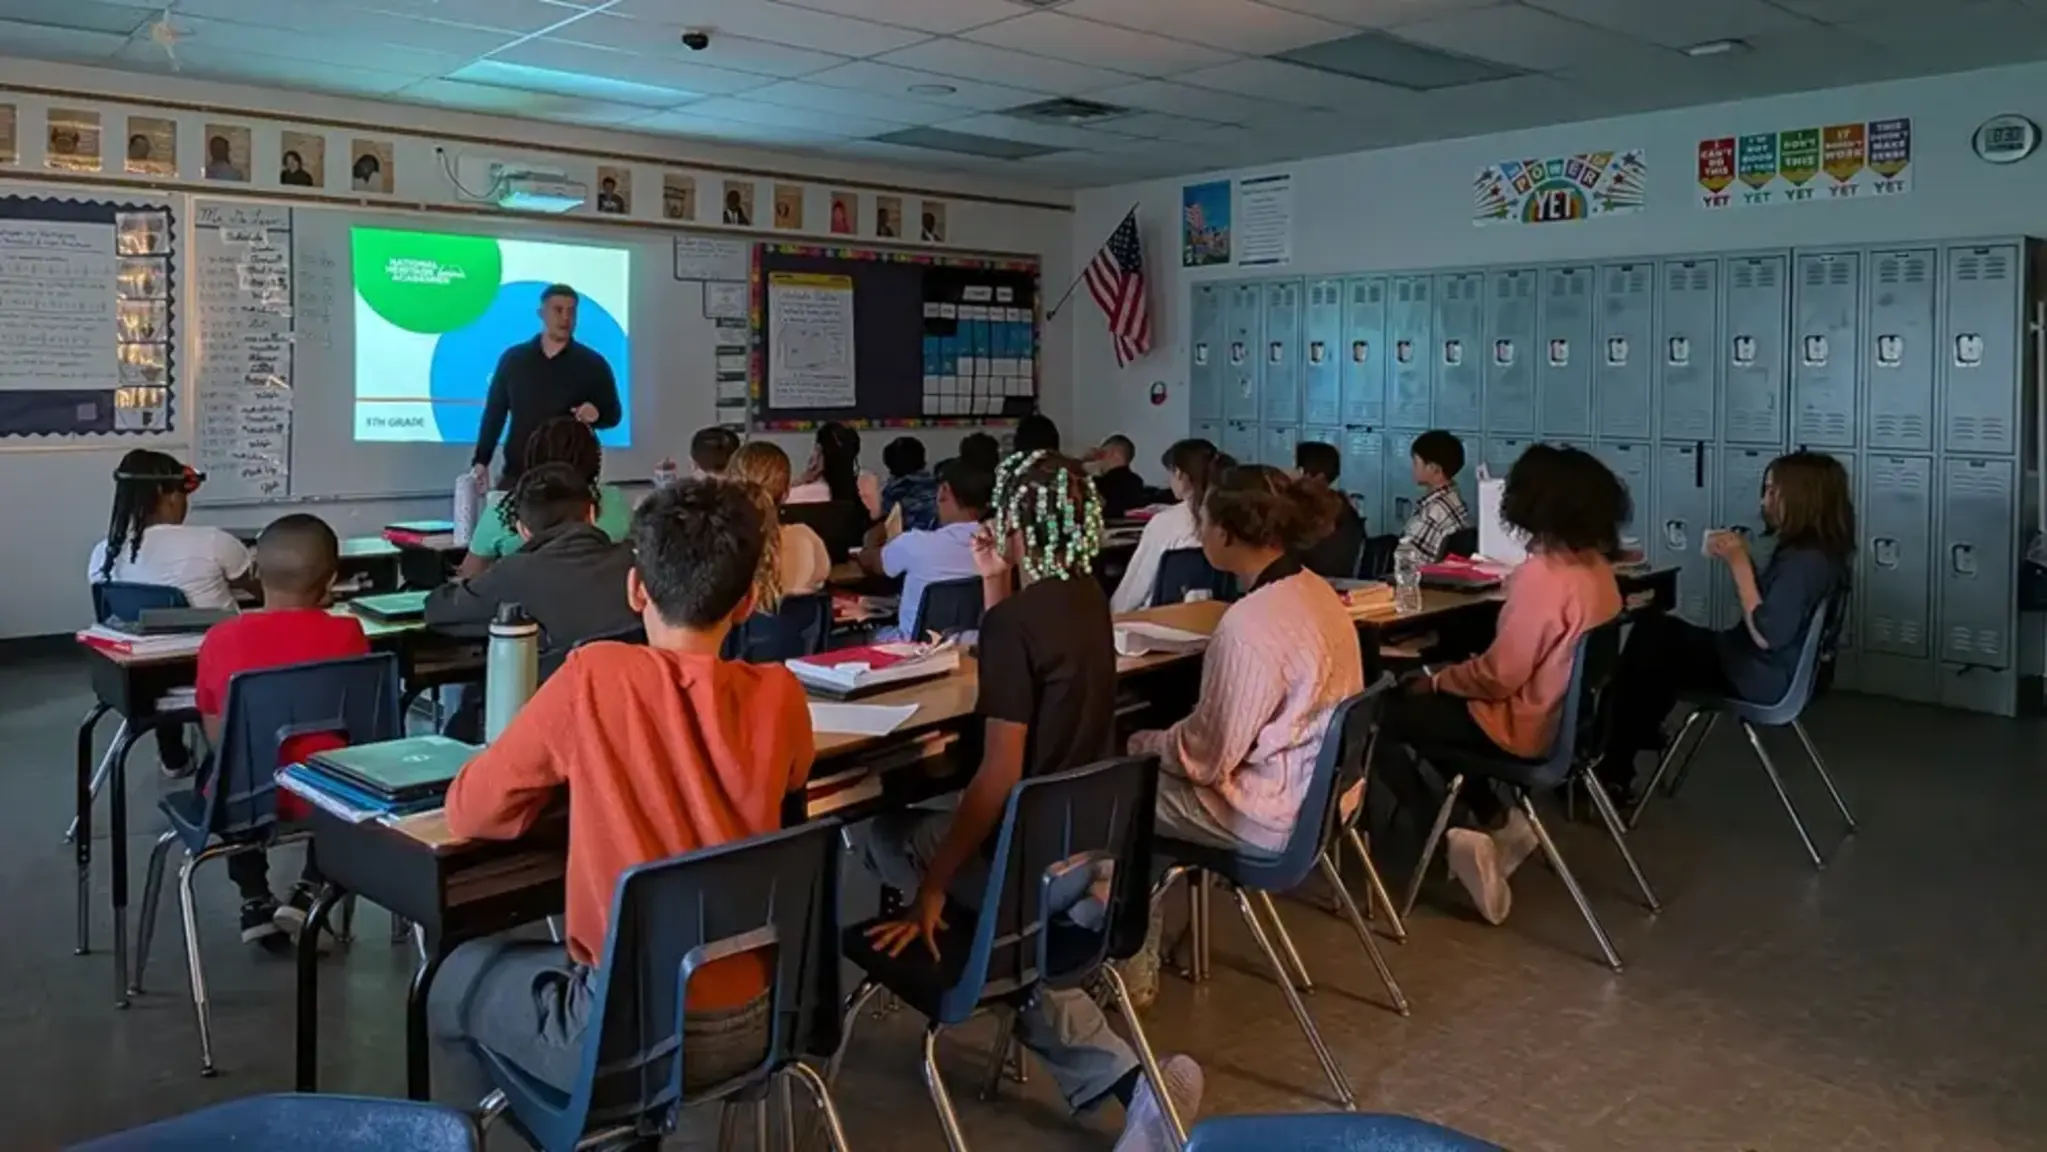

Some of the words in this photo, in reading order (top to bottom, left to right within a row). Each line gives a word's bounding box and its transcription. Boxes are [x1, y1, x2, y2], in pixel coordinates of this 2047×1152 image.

[1829, 184, 1860, 197] YET
[1874, 180, 1905, 194] YET
[1744, 192, 1772, 203] YET
[1784, 188, 1815, 200] YET
[1535, 189, 1573, 219] YET
[1702, 195, 1730, 207] YET
[387, 417, 425, 428] GRADE
